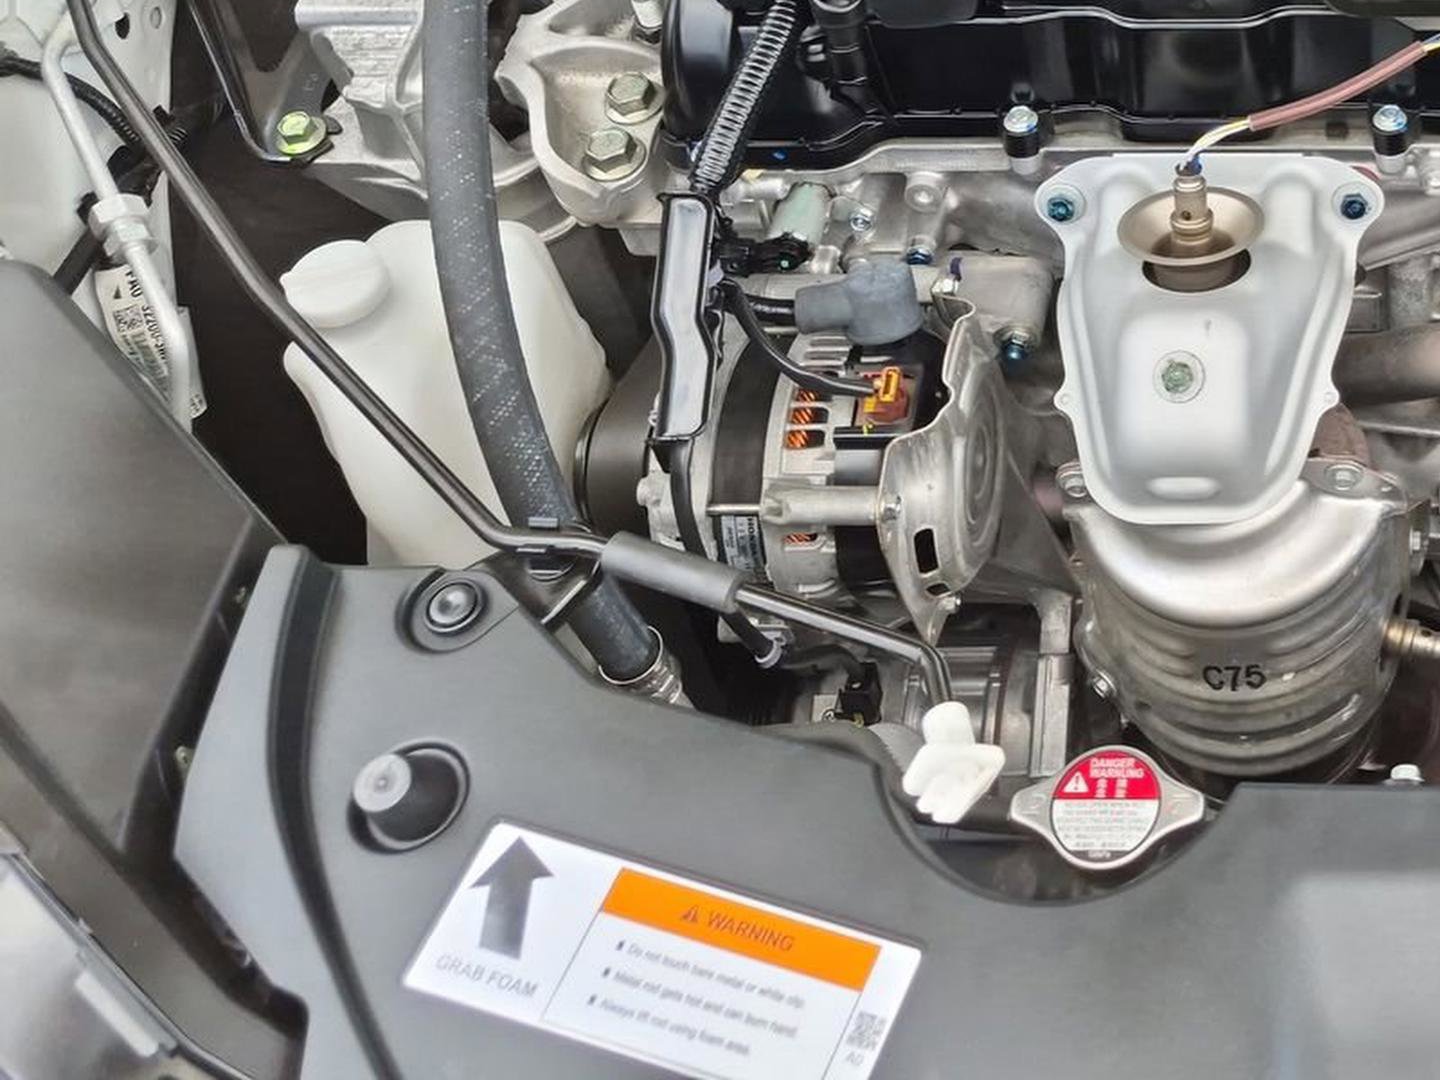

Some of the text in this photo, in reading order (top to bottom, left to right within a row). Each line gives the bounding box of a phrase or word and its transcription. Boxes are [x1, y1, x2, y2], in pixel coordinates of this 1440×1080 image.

[1203, 664, 1267, 691] C75
[708, 910, 796, 952] WARNING
[436, 953, 538, 997] GRAB FOAM
